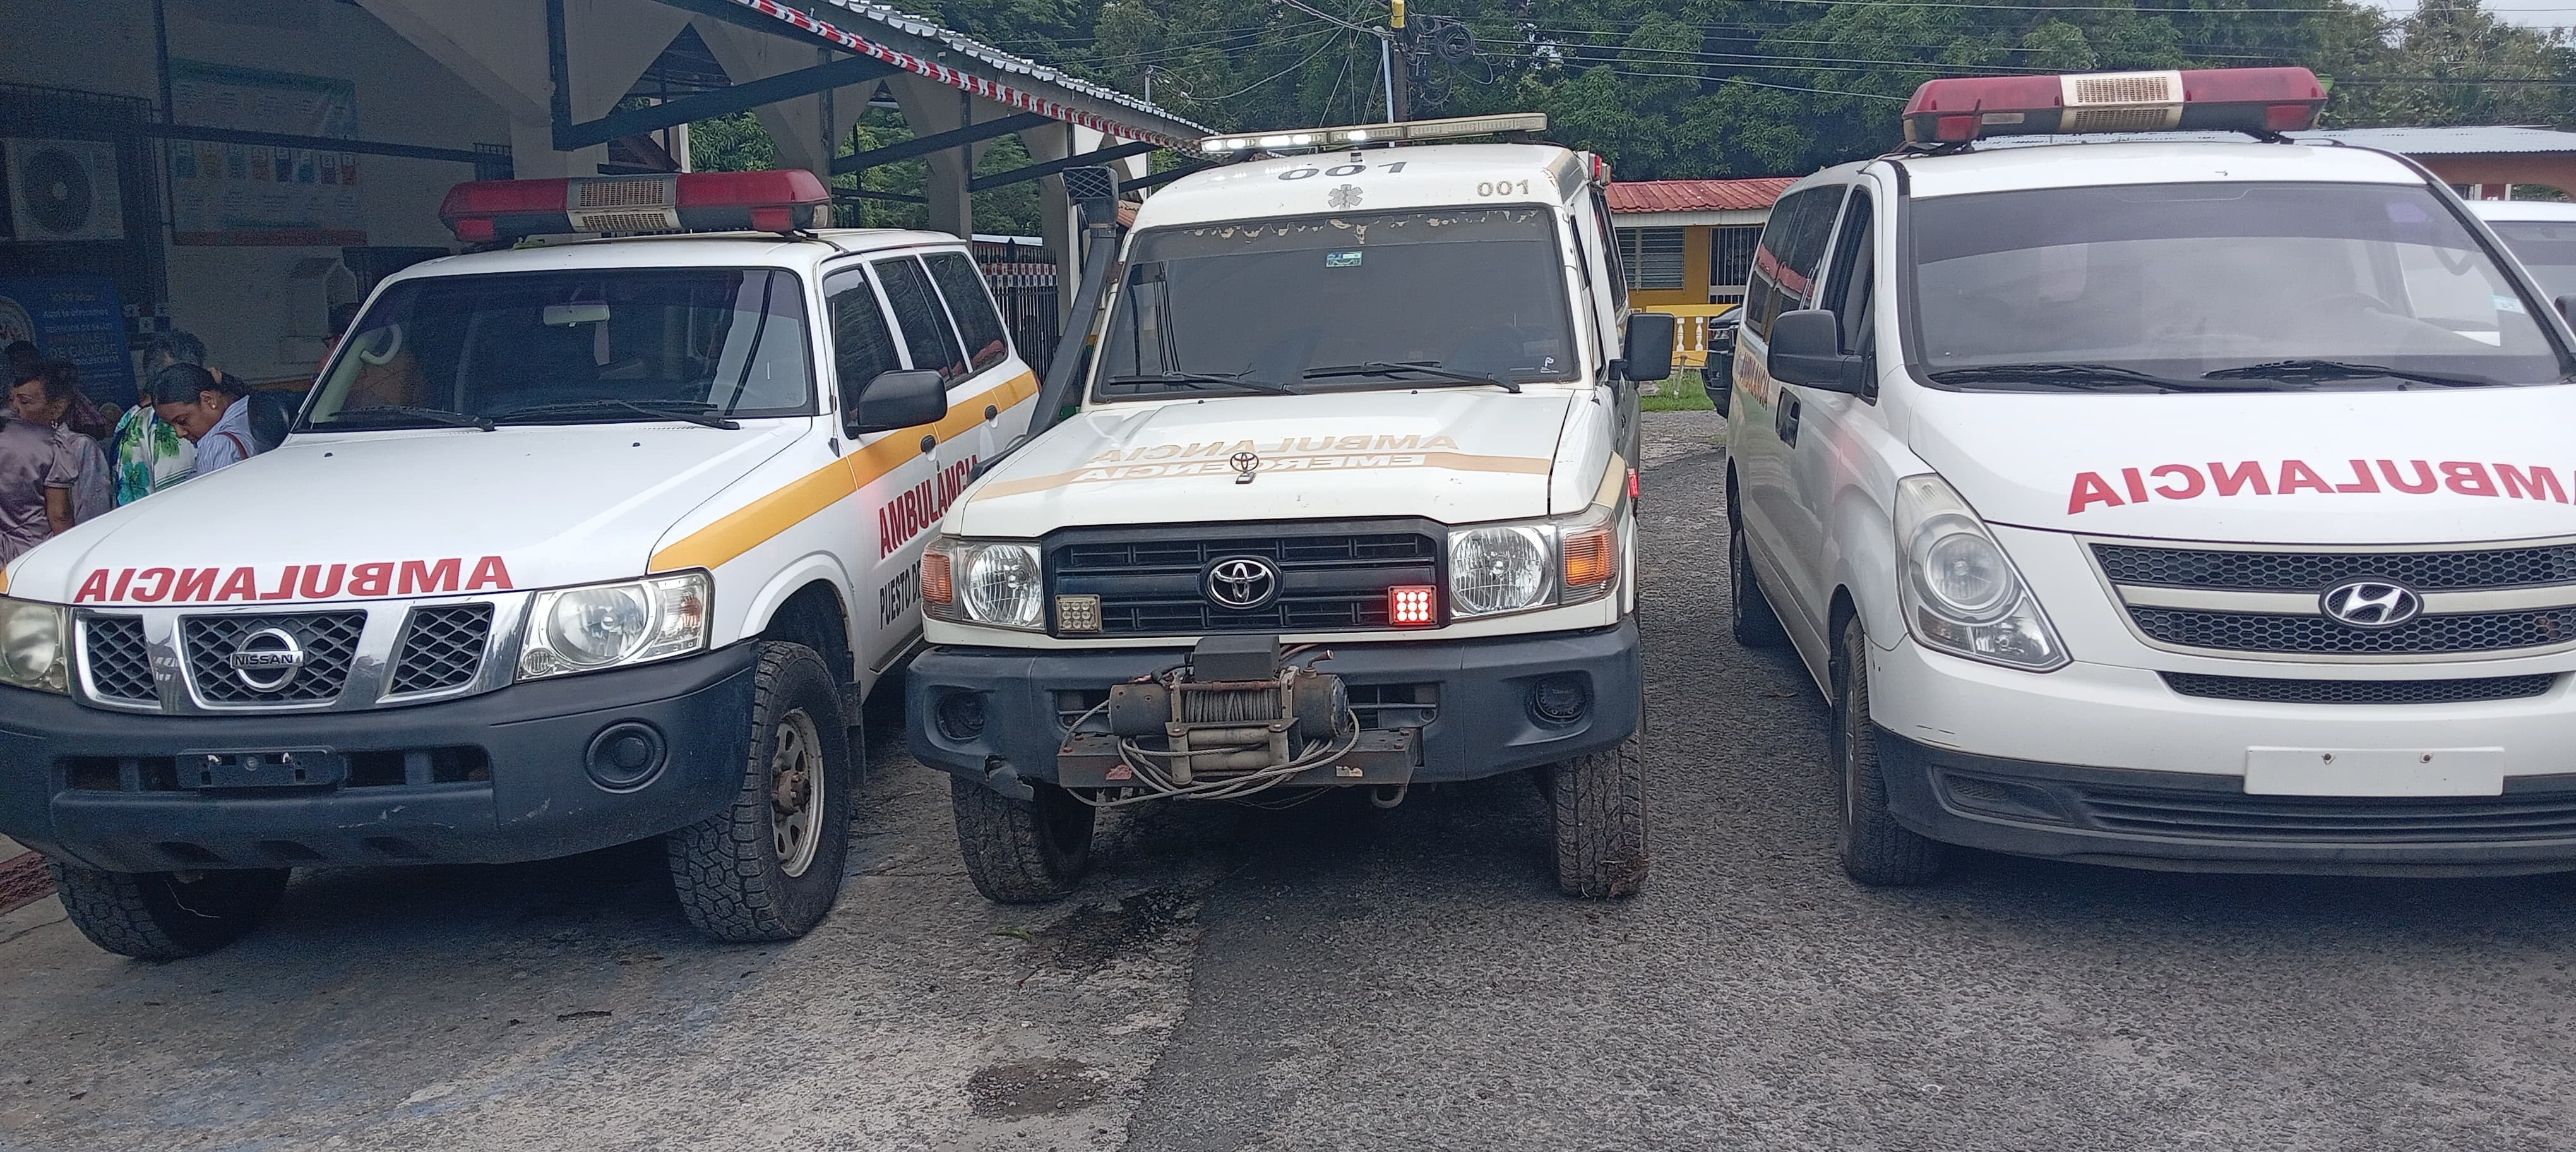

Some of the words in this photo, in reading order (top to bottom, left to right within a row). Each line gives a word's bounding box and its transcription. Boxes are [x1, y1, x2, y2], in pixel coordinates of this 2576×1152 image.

[1278, 161, 1408, 181] 001
[1477, 179, 1530, 198] 001
[49, 347, 66, 359] DE
[68, 344, 118, 357] CALIDAD
[879, 454, 978, 560] AMBULANCI
[880, 568, 911, 630] PUESTO
[236, 654, 294, 666] NISSAN
